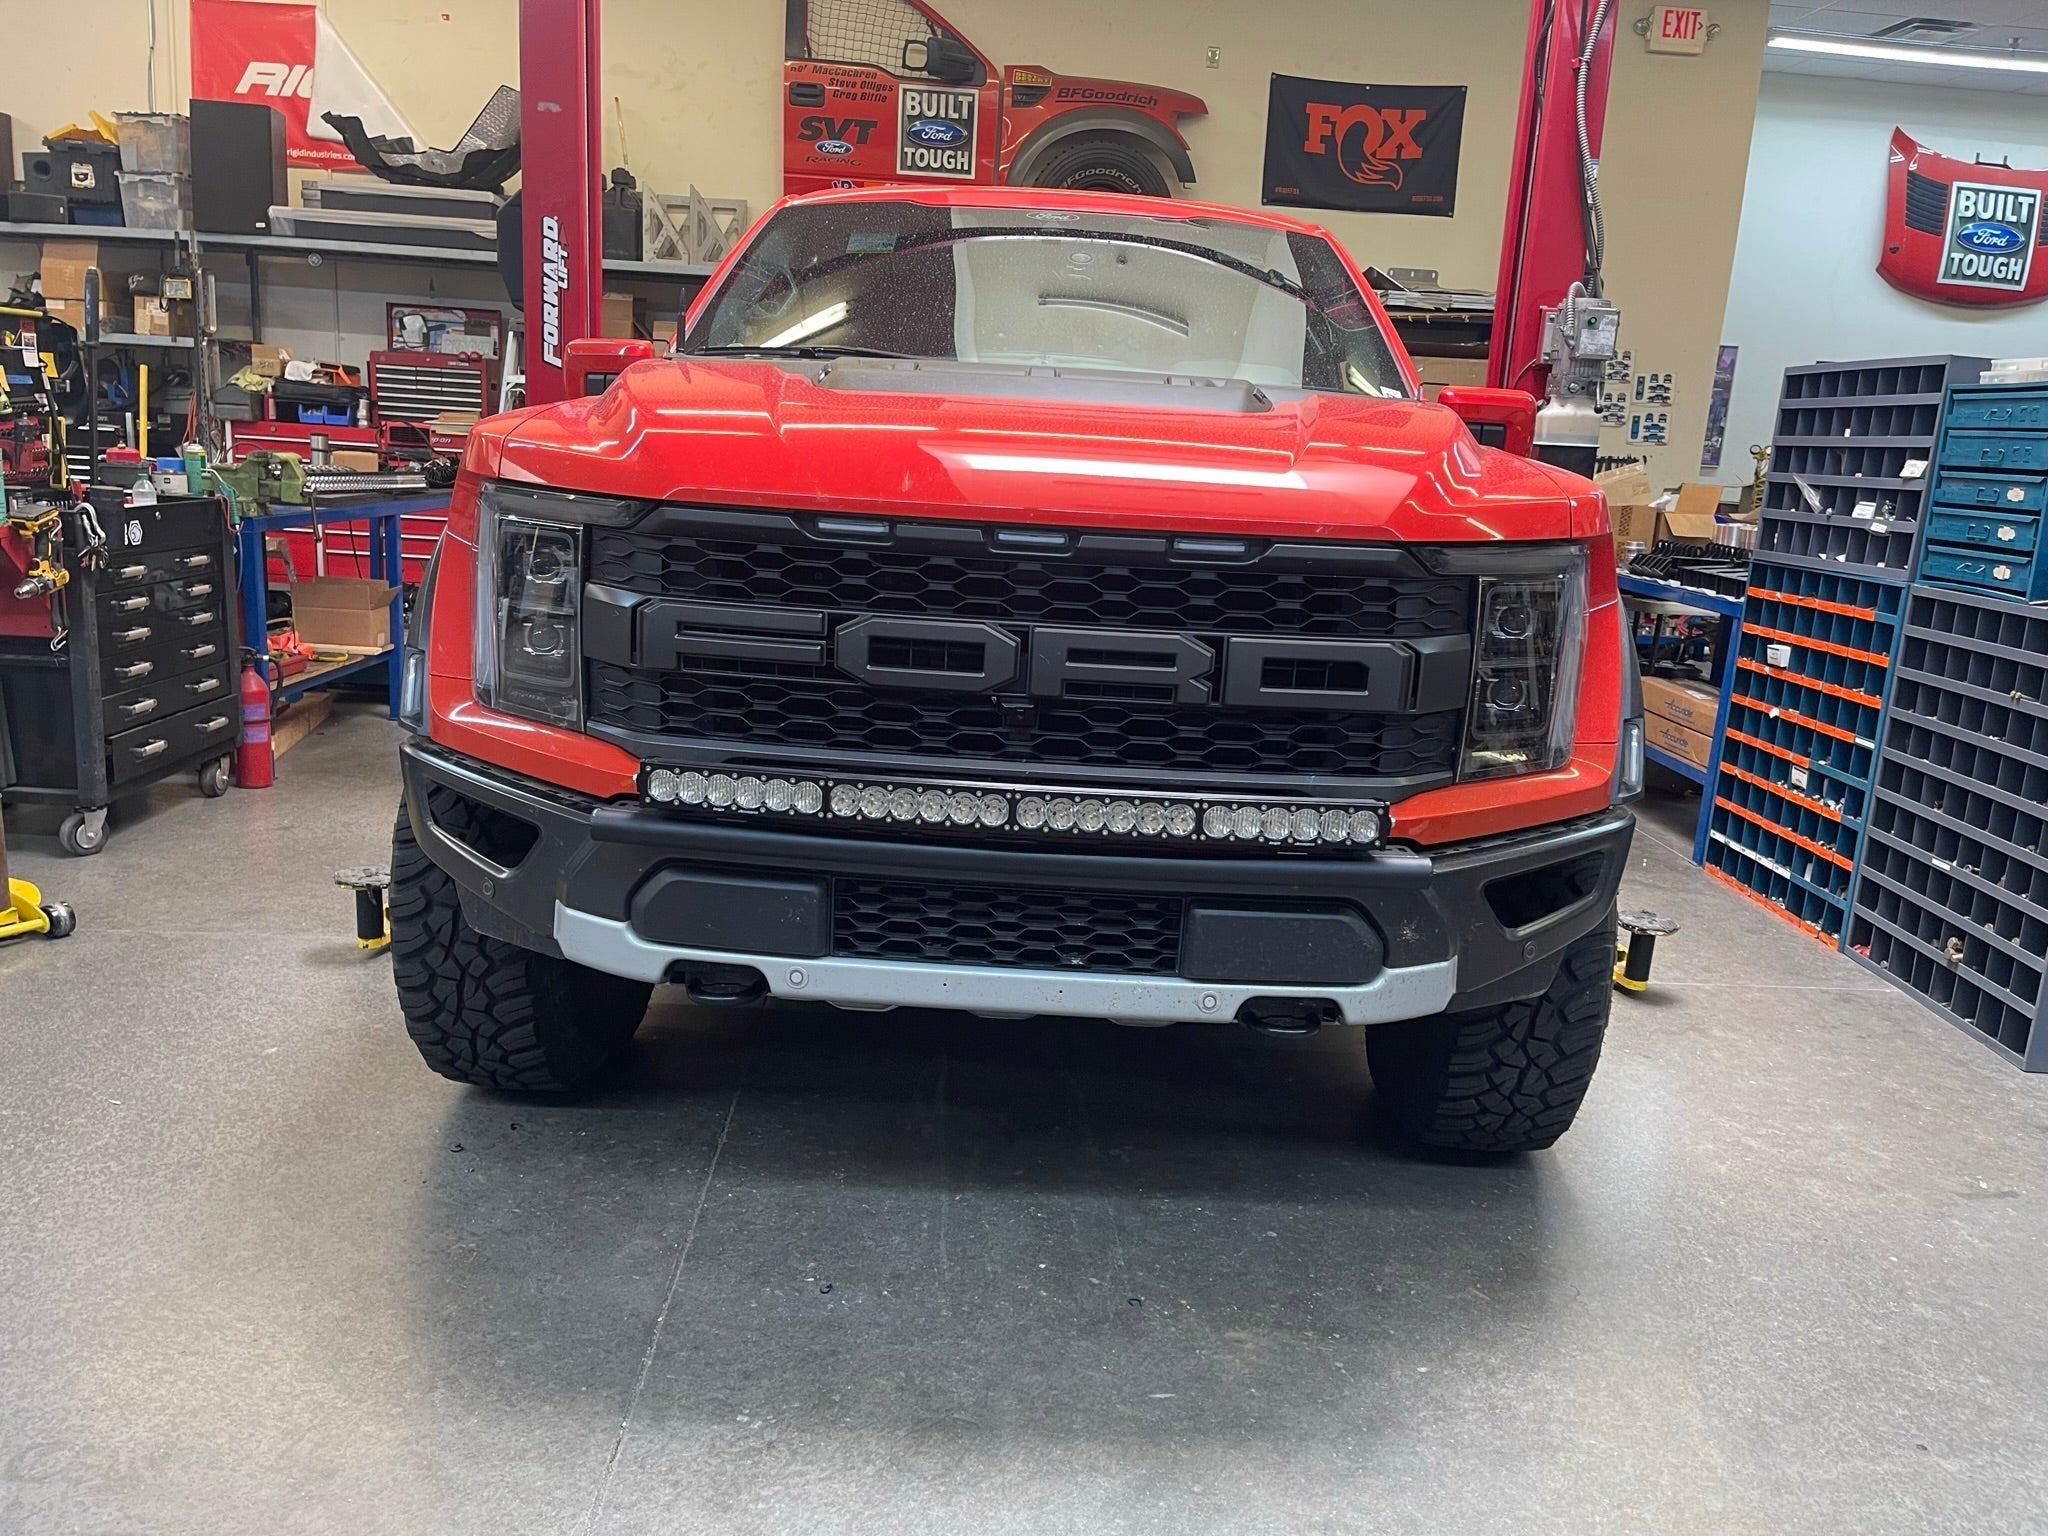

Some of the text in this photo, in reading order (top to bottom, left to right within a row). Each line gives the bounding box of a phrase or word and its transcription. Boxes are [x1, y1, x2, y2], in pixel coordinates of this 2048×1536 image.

[1662, 9, 1701, 40] EXIT
[828, 78, 857, 89] Steve
[832, 89, 888, 103] Greg Biffle
[905, 91, 973, 120] BUILT
[1057, 87, 1158, 107] BFGoodrich
[797, 115, 879, 145] SVT
[921, 125, 954, 141] Ford
[1304, 102, 1427, 160] FOX
[822, 142, 847, 153] Ford
[903, 147, 969, 171] TOUGH
[805, 156, 863, 167] RACING
[1958, 190, 2035, 224] BUILT
[1972, 228, 2010, 247] Ford
[1950, 252, 2024, 281] TOUGH
[542, 216, 569, 368] FORWARD LIFT
[634, 600, 1416, 714] FORD
